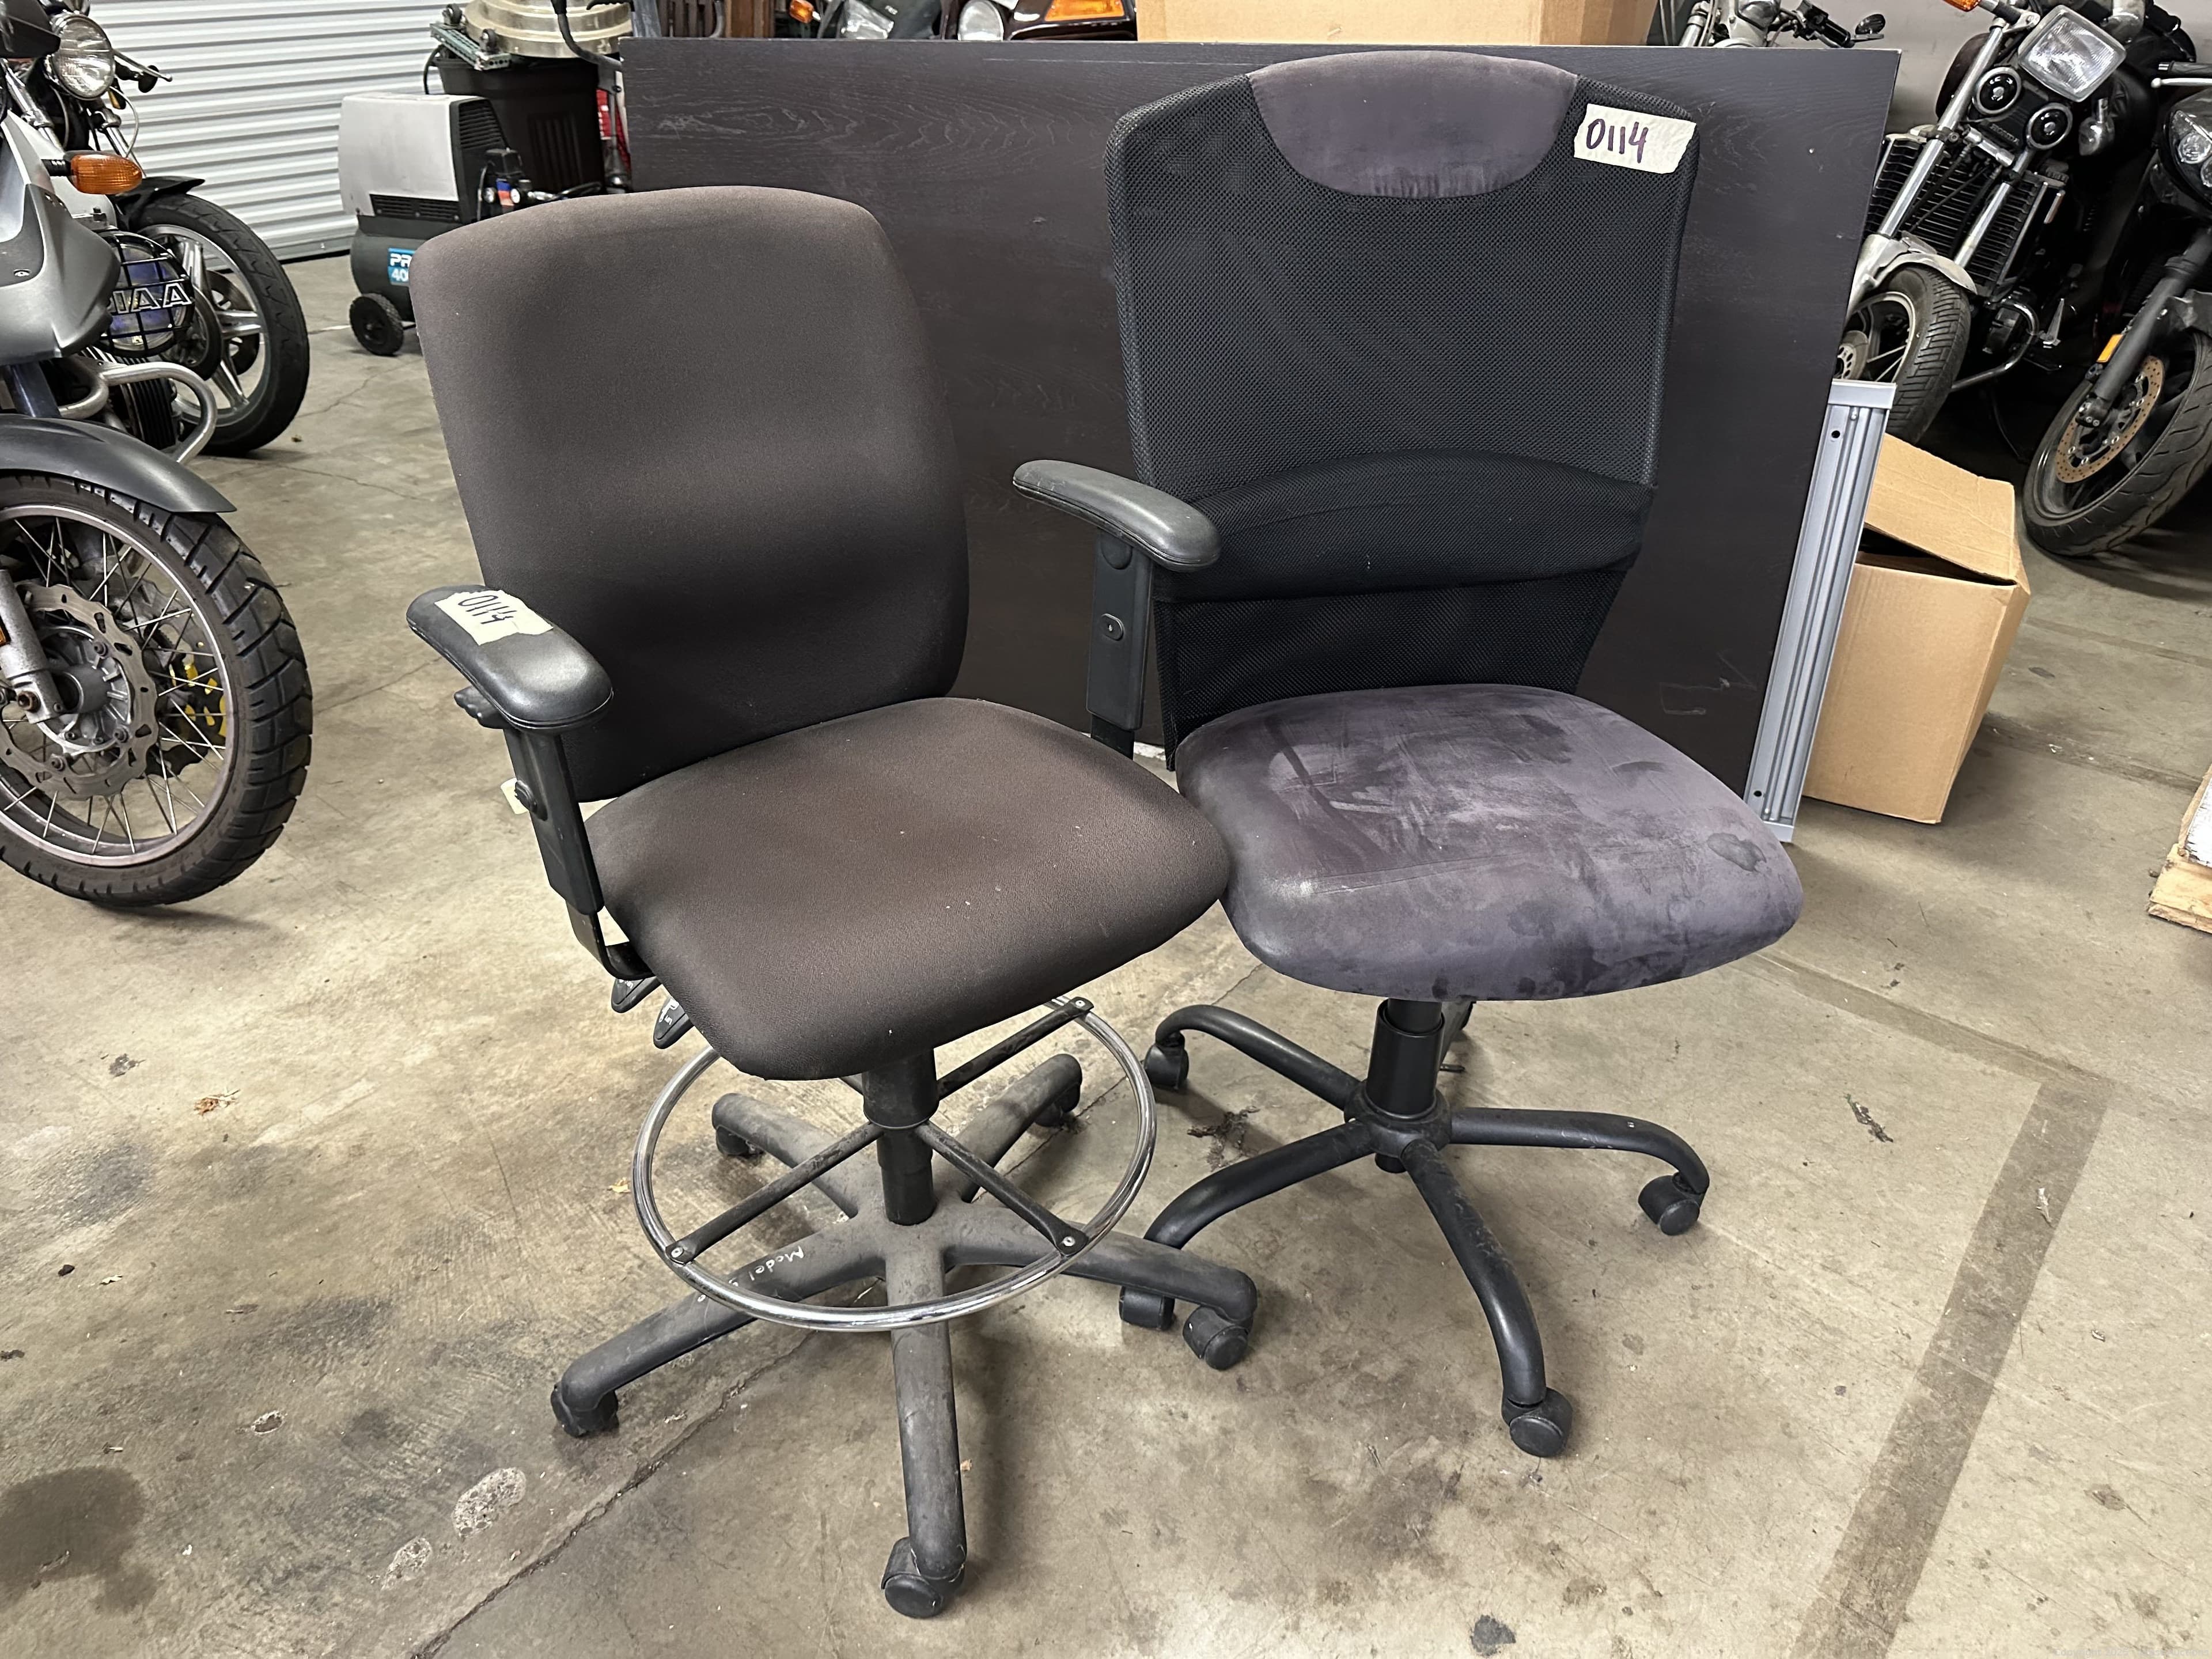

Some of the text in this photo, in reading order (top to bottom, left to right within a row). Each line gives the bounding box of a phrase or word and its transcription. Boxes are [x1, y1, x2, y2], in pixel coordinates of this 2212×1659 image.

[1586, 118, 1649, 164] 0114
[1989, 123, 2020, 146] HONDA
[391, 268, 409, 282] 40
[112, 283, 192, 314] IAA
[458, 595, 517, 624] 0114
[748, 1245, 805, 1281] Model
